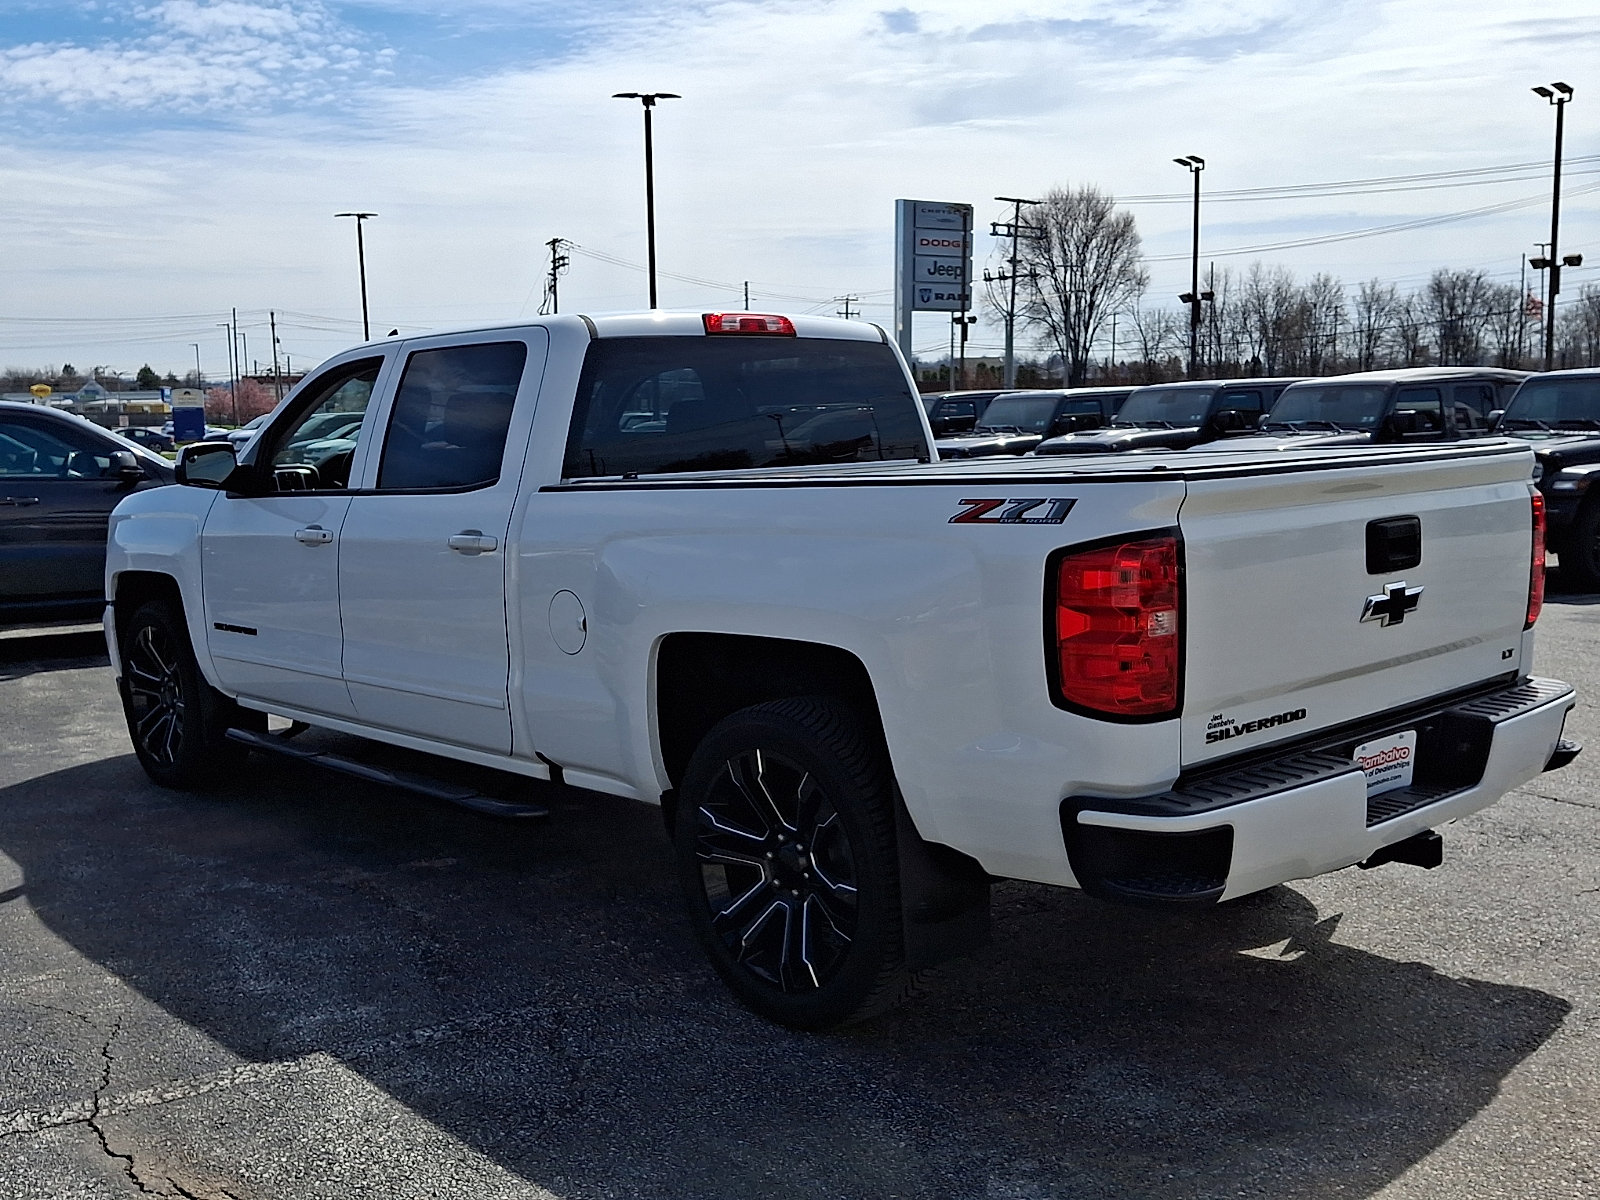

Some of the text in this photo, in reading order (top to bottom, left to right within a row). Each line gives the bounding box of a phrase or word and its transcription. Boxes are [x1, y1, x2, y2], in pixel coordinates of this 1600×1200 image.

[927, 260, 963, 279] Jeep
[948, 498, 1078, 524] Z71
[1502, 648, 1514, 660] LT
[1205, 708, 1307, 744] SILVERADO
